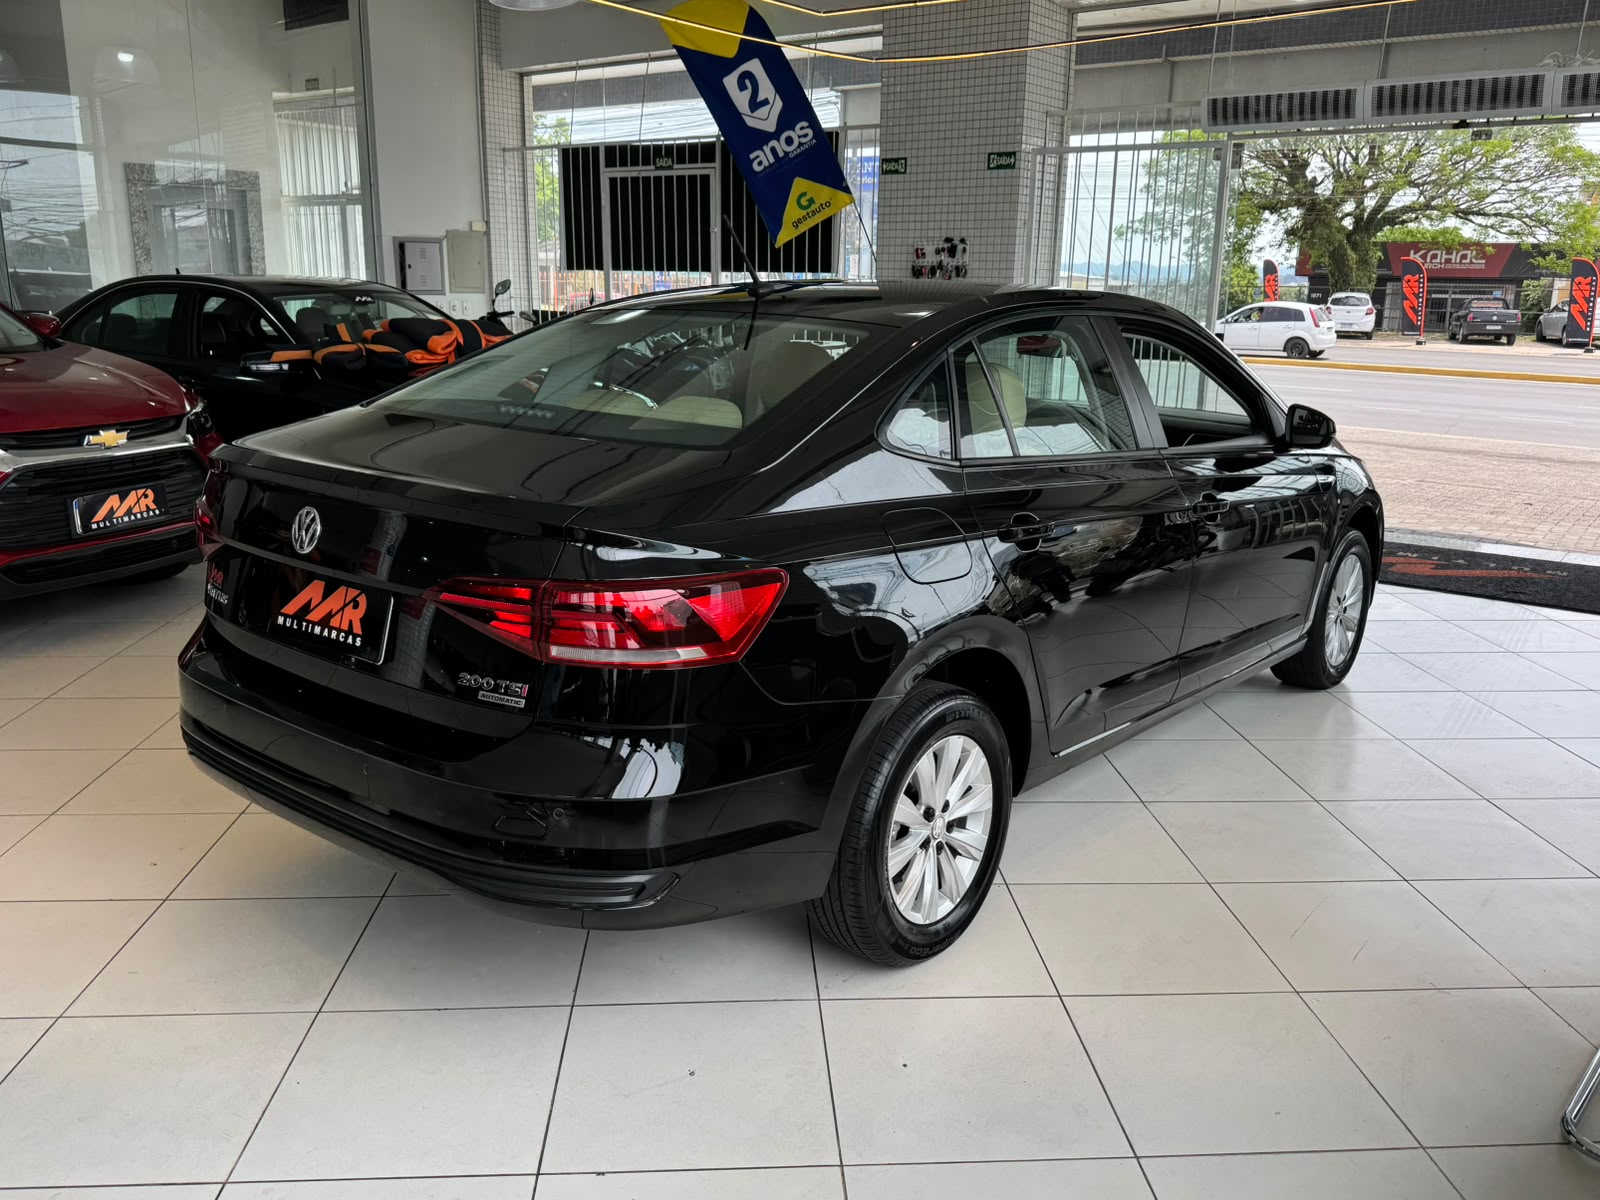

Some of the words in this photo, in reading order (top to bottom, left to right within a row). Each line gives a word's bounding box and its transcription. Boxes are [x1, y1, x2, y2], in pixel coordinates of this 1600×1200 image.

[737, 71, 770, 113] 2
[749, 121, 814, 172] anos
[789, 138, 817, 159] GARANTIA
[791, 201, 832, 230] gestauto
[91, 508, 160, 530] MULTIMARCAS
[277, 615, 362, 646] MULTIMARCAS
[457, 672, 494, 690] 200
[496, 679, 529, 697] TSI
[480, 693, 522, 706] AUTOMATIC
